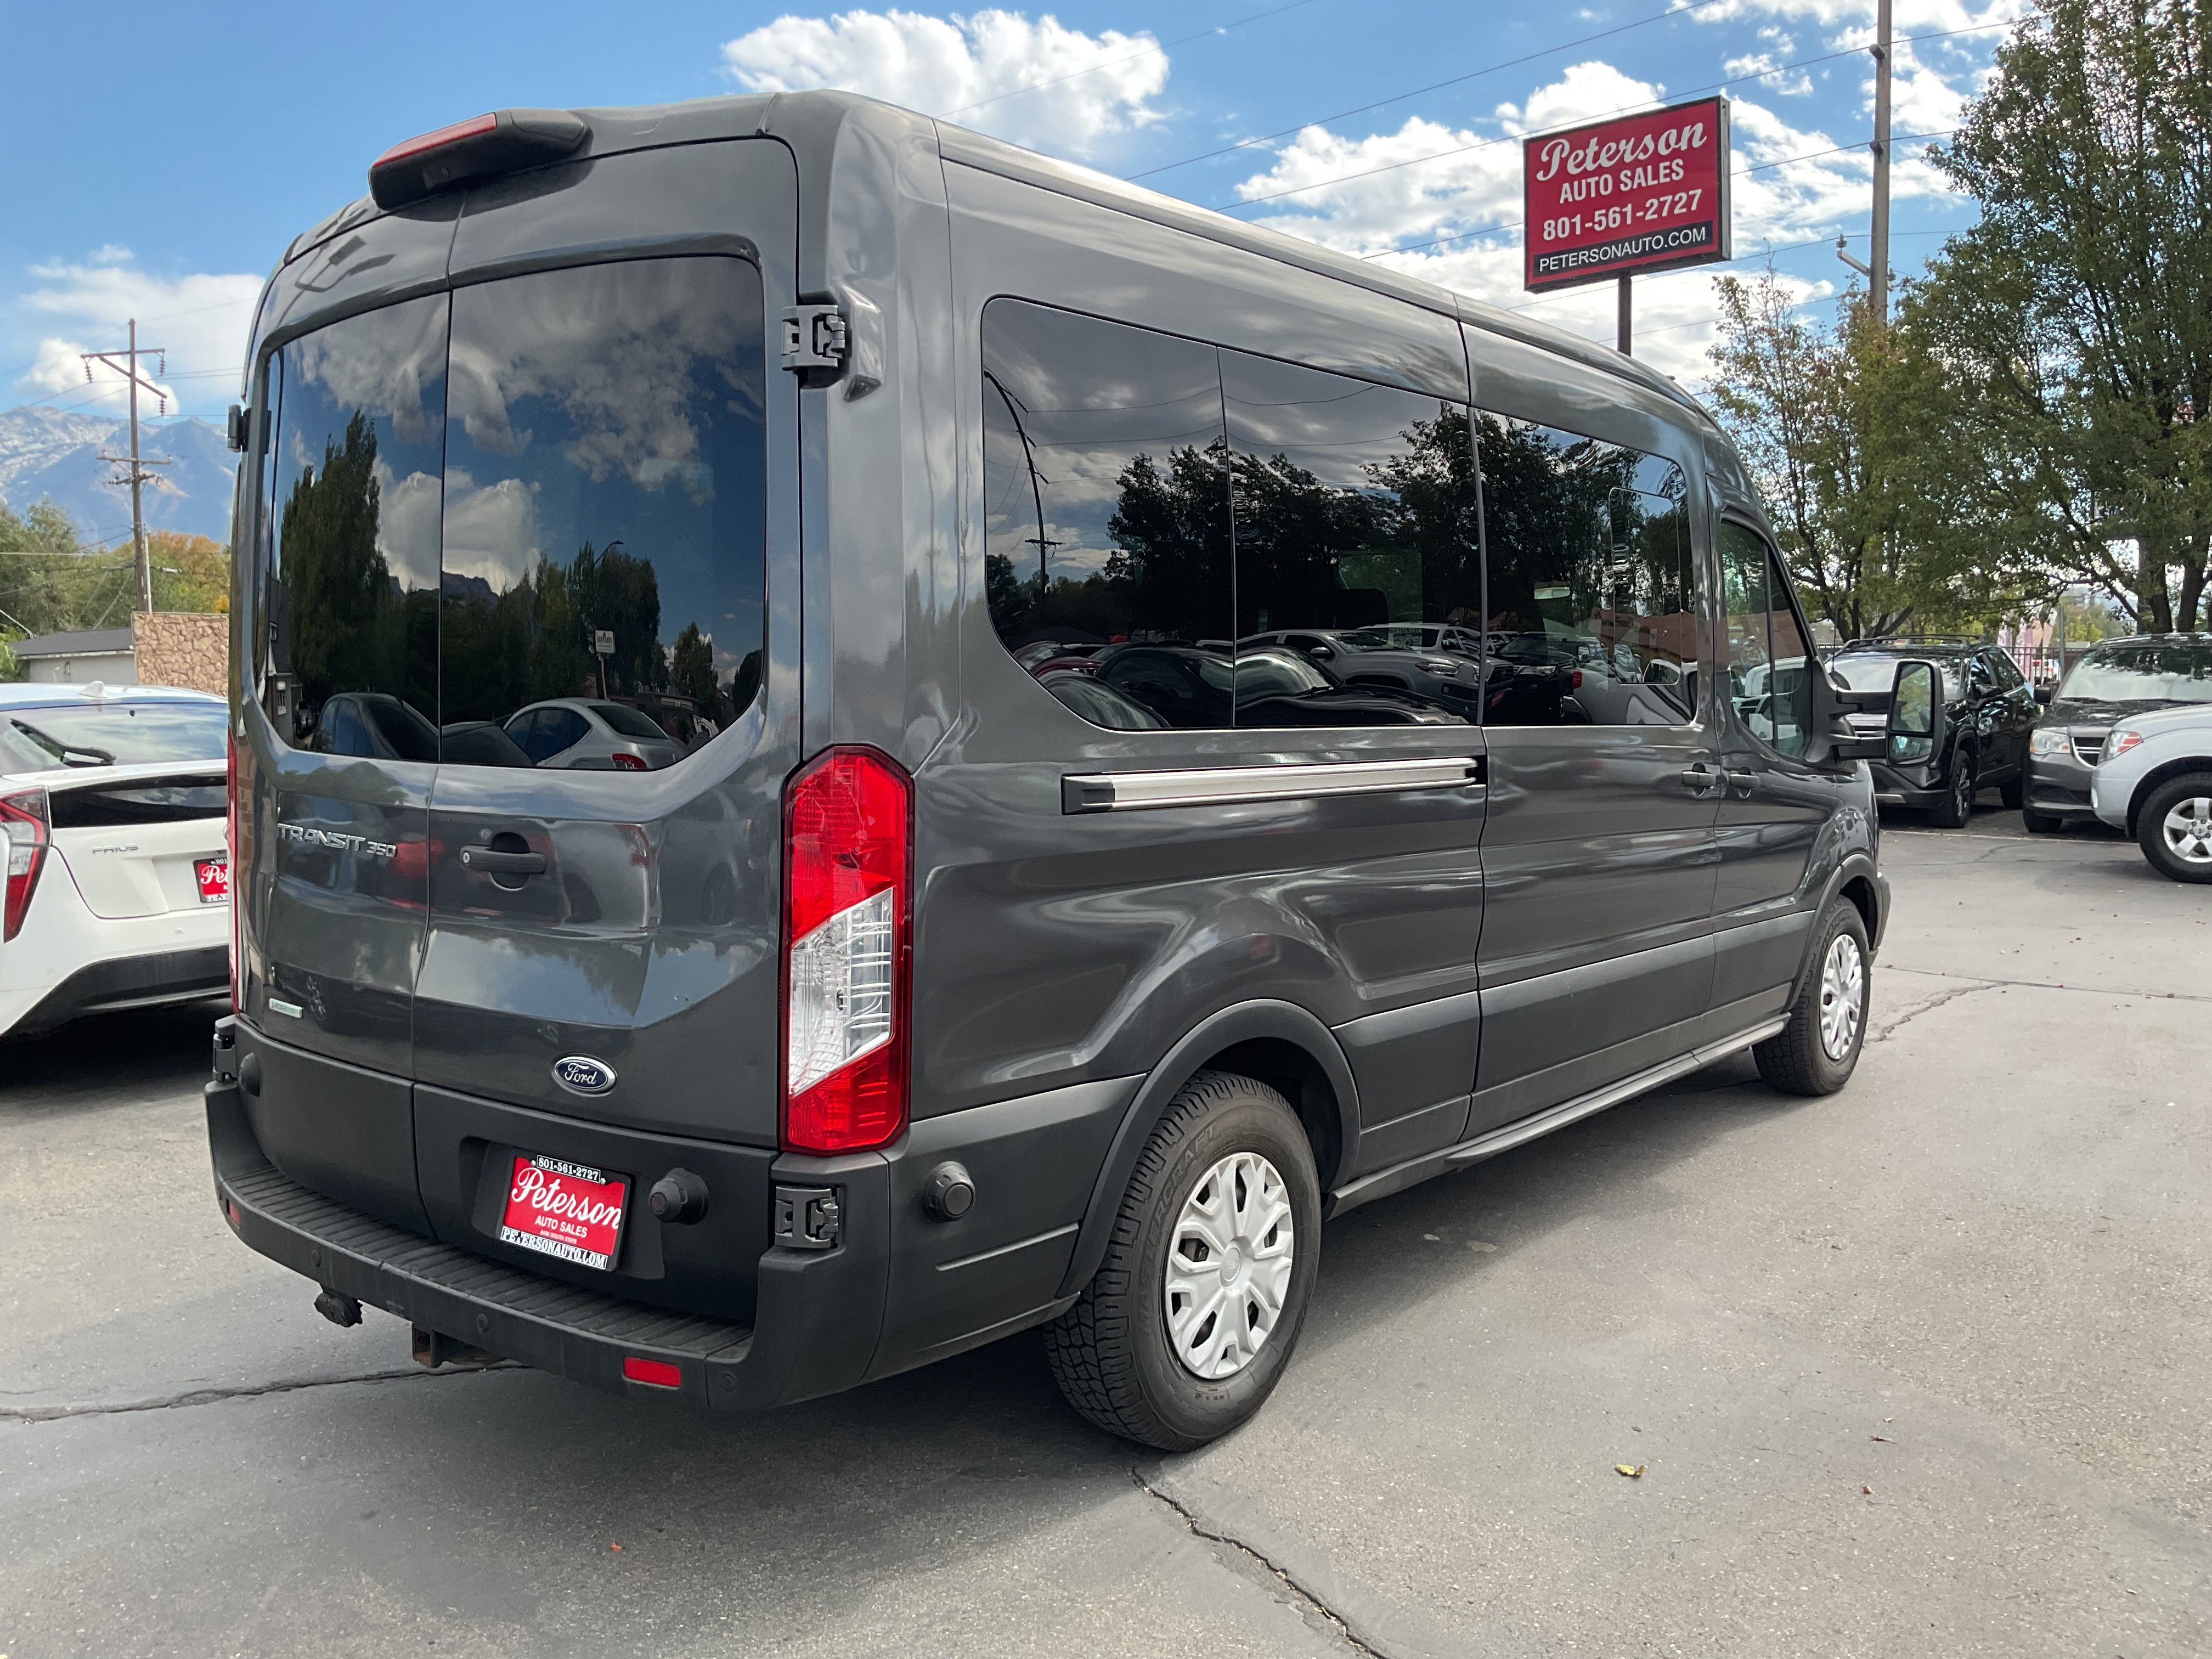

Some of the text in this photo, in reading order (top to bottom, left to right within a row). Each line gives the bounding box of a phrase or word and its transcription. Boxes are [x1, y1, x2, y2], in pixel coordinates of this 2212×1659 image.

[1536, 122, 1707, 182] Peterson
[1559, 159, 1684, 204] AUTO SALES
[1543, 189, 1702, 241] 801-561-2727
[1539, 227, 1706, 272] PETERSONAUTO.COM
[92, 845, 138, 855] PRIUS
[278, 822, 397, 857] TRANSIT 350
[565, 1063, 597, 1085] Ford
[538, 1157, 599, 1181] 801-561-2727
[511, 1167, 622, 1229] Peterson
[535, 1215, 558, 1229] AUTO
[560, 1222, 588, 1238] SALES
